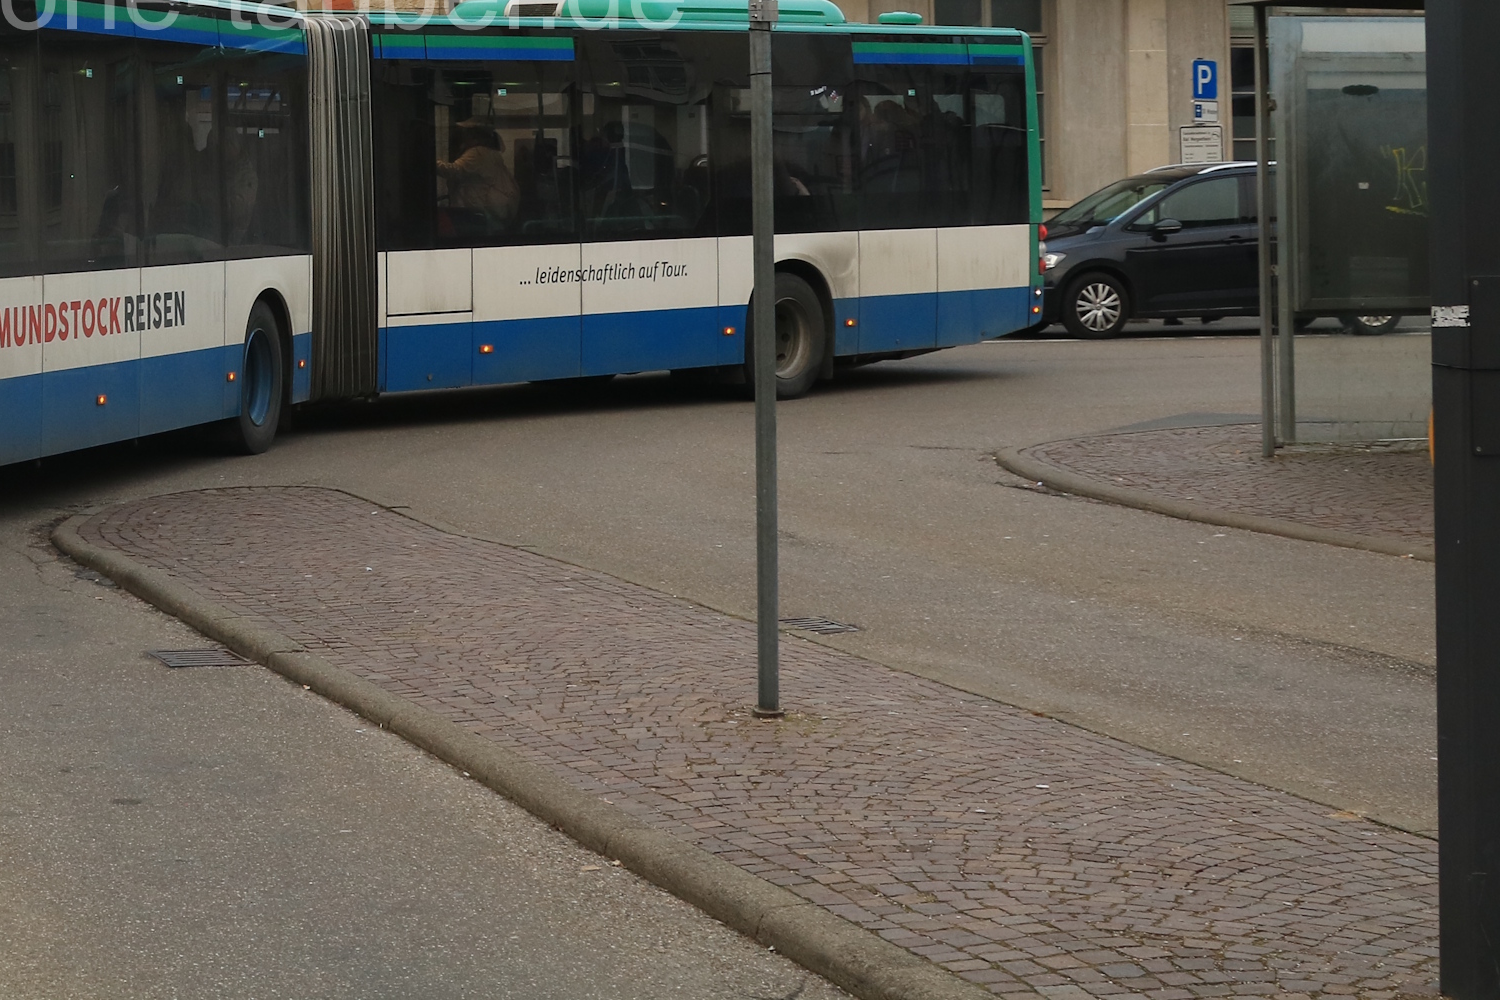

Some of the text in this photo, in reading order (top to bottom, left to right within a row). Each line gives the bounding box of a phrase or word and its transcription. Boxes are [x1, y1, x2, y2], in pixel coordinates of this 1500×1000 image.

[1197, 64, 1212, 95] P
[535, 263, 635, 285] leidenschaftlich
[638, 261, 659, 282] auf
[661, 261, 688, 278] Tour.
